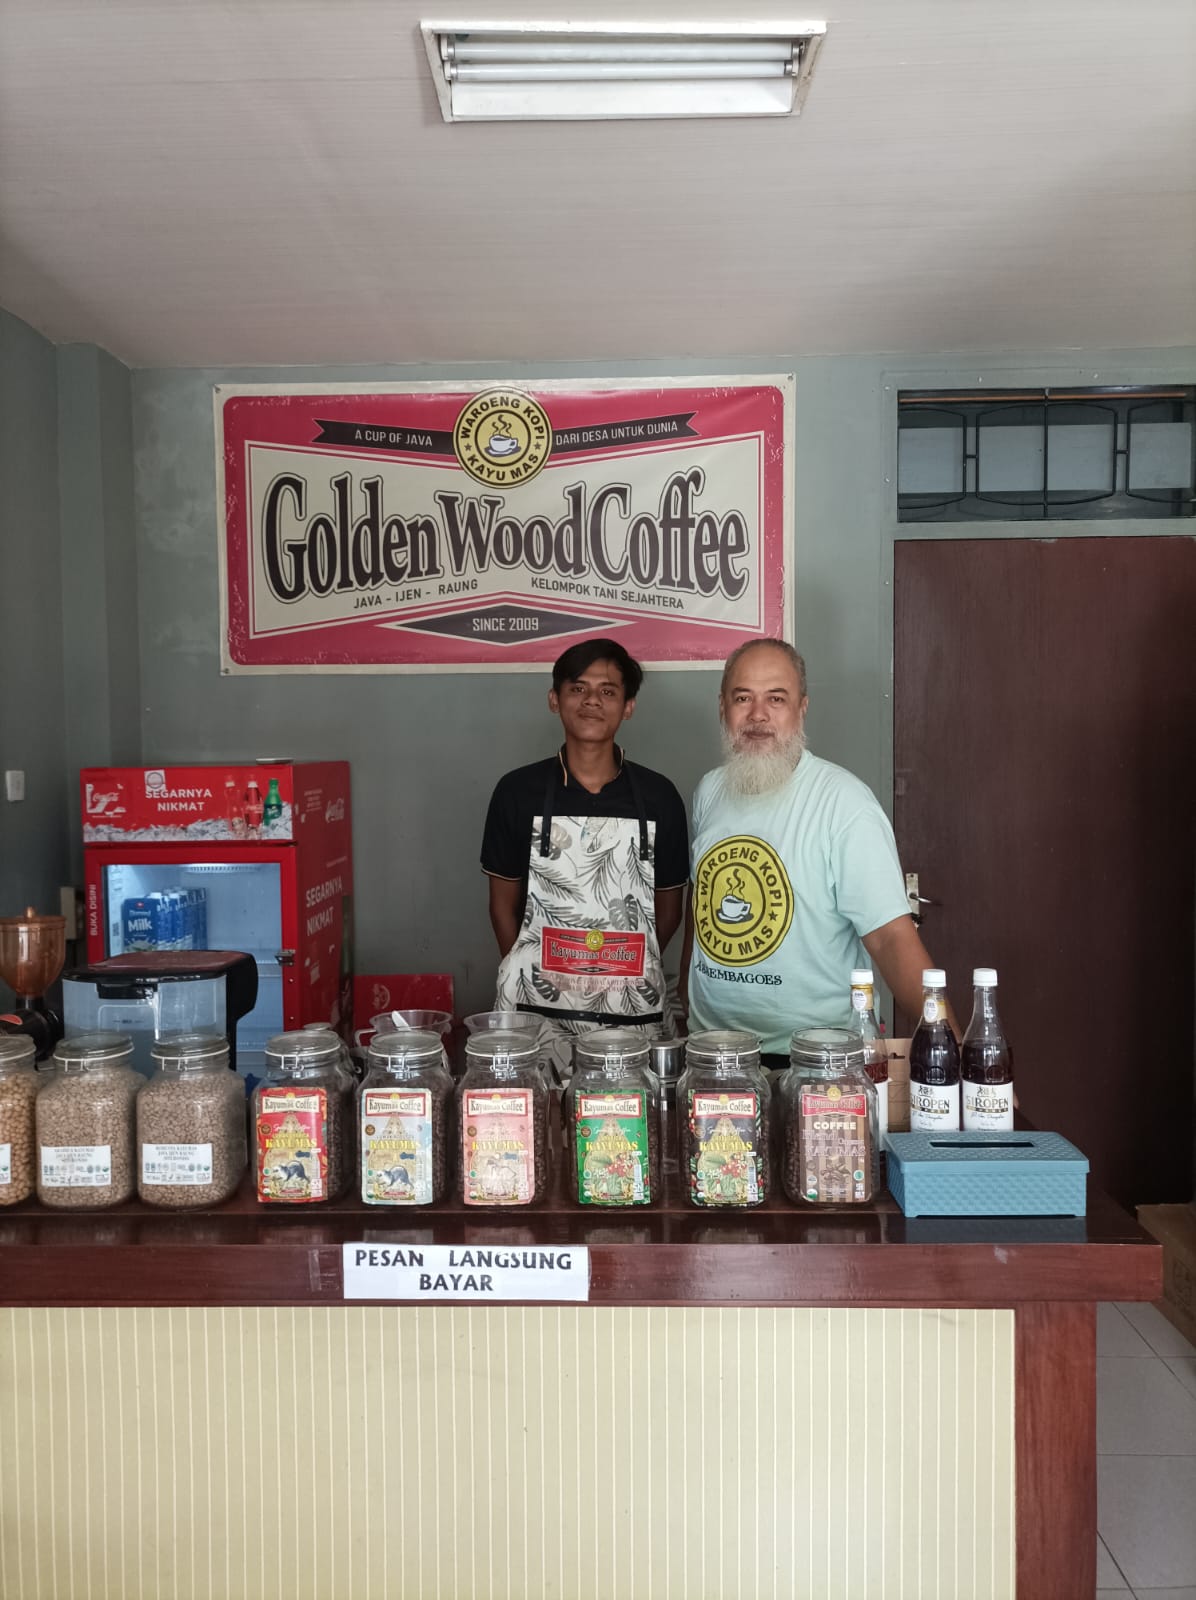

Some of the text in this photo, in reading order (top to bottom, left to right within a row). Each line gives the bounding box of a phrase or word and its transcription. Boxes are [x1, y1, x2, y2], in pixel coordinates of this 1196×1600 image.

[460, 396, 545, 440] WAROENG KOPI
[354, 430, 433, 447] A CUP OF JAVA
[555, 421, 678, 446] DARI DESA UNTUK DUNIA
[467, 453, 539, 481] KAYU MAS
[353, 594, 382, 609] JAVA
[395, 589, 422, 603] IJEN
[438, 578, 478, 595] RAUNG
[531, 576, 685, 610] KELOMPOK TANI SEJAHTERA
[472, 617, 539, 631] SINCE 2009
[145, 788, 213, 799] SEGARNYA
[157, 801, 205, 812] NIKMAT
[700, 846, 783, 908] WAROENG KOPI
[305, 876, 343, 908] SEGARNYA
[88, 884, 98, 936] BUKA DISINI
[127, 918, 153, 932] Milk
[306, 906, 334, 937] NIKMAT
[700, 915, 774, 956] KAYU MAS
[550, 941, 637, 961] Kayumas Coffee
[614, 1101, 637, 1113] Coffee
[729, 1100, 752, 1112] Coffee
[966, 1095, 1009, 1109] SIROPEN
[813, 1121, 857, 1130] COFFEE
[265, 1138, 318, 1149] KAYUMAS
[369, 1139, 422, 1150] KAYUMAS
[471, 1140, 525, 1151] KAYUMAS
[585, 1141, 639, 1151] KAYUMAS
[699, 1141, 753, 1152] KAYUMAS
[355, 1249, 573, 1270] PESAN LANGSUNG
[419, 1273, 494, 1292] BAYAR
